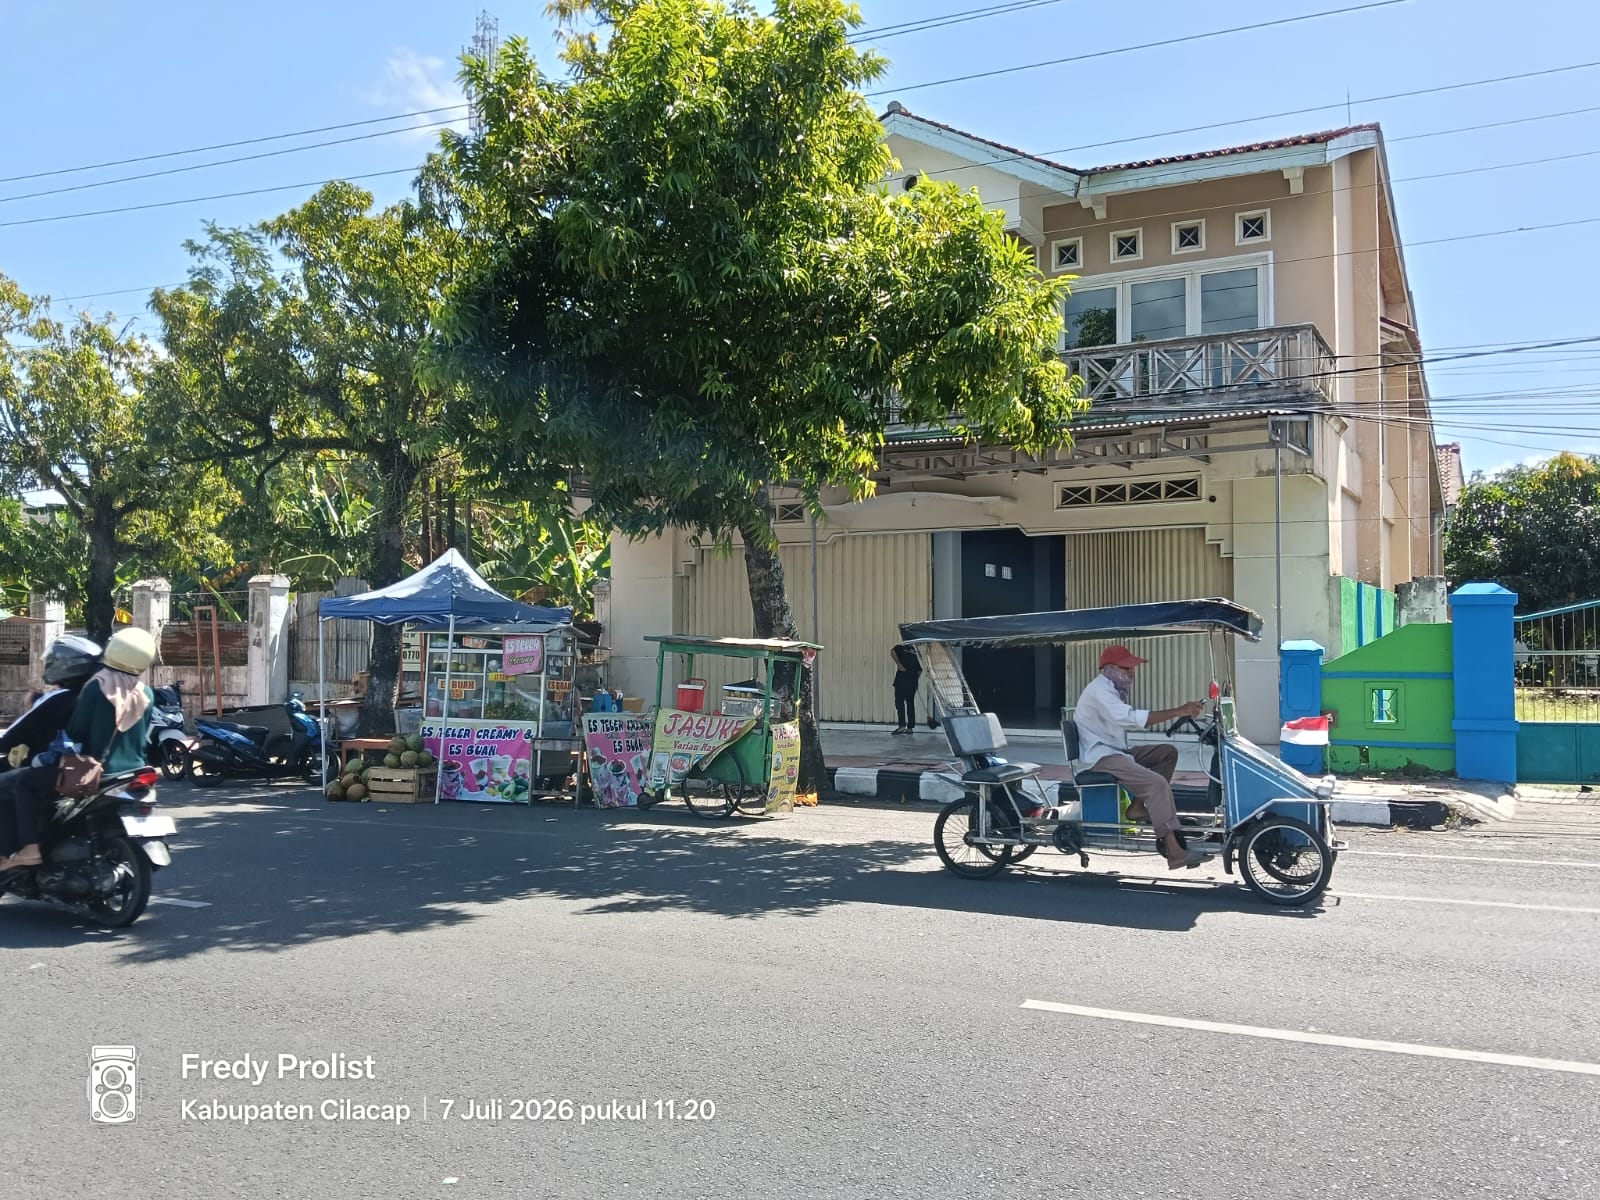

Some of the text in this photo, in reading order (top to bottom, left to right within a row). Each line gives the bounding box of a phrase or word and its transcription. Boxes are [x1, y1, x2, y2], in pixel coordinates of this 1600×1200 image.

[451, 680, 475, 689] BUAH
[588, 719, 598, 733] ES
[663, 713, 745, 740] JASUKE
[421, 727, 434, 738] ES
[475, 728, 520, 740] CREAMY
[523, 728, 534, 740] &
[449, 744, 497, 756] ES BUAH
[613, 740, 623, 753] ES
[700, 742, 718, 752] Ras
